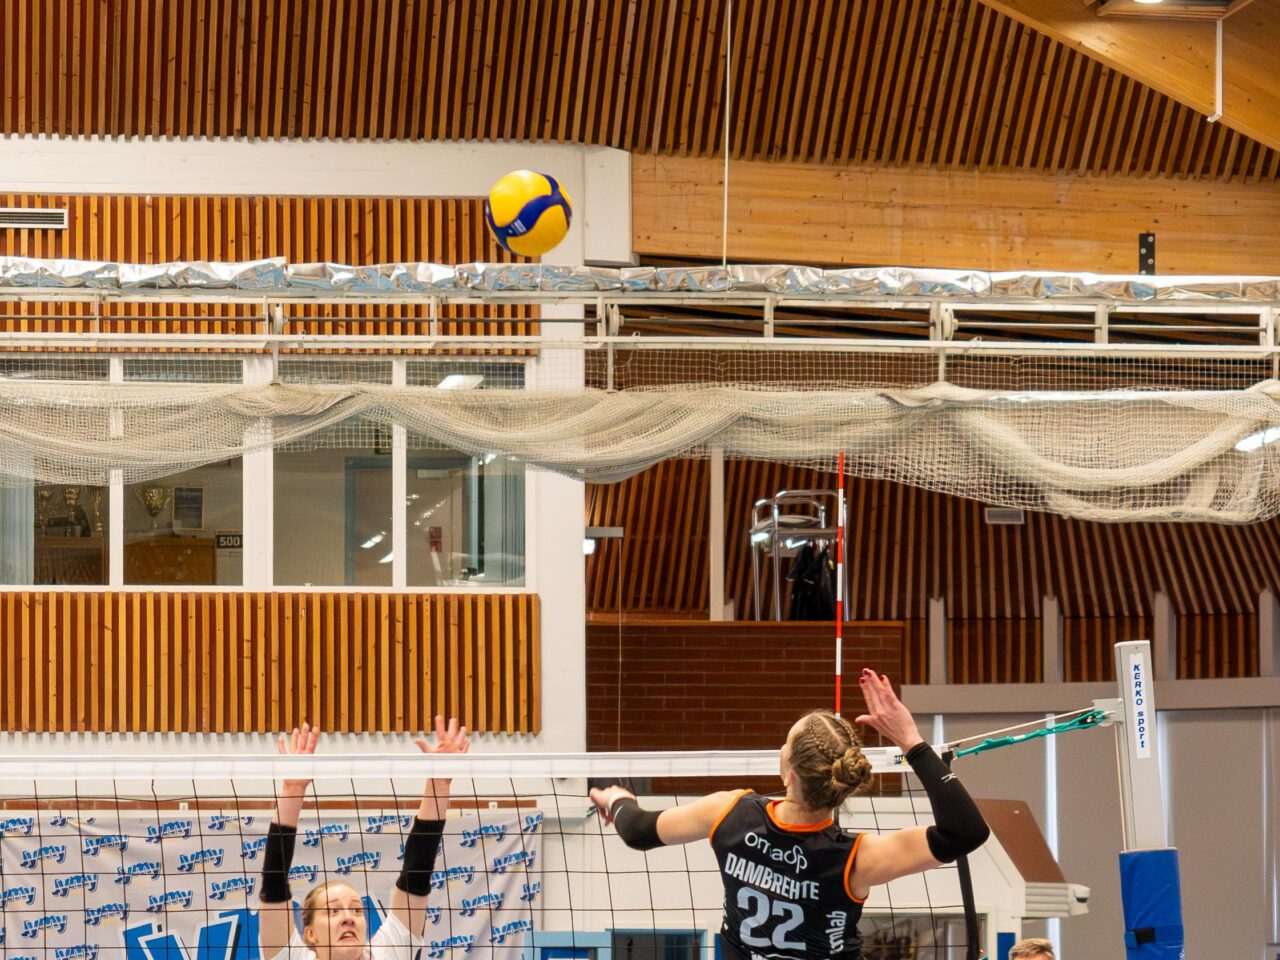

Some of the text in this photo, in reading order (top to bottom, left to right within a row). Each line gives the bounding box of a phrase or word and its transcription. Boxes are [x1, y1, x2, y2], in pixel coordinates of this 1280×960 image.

[1133, 664, 1145, 748] KERKO sport
[737, 886, 807, 951] 22
